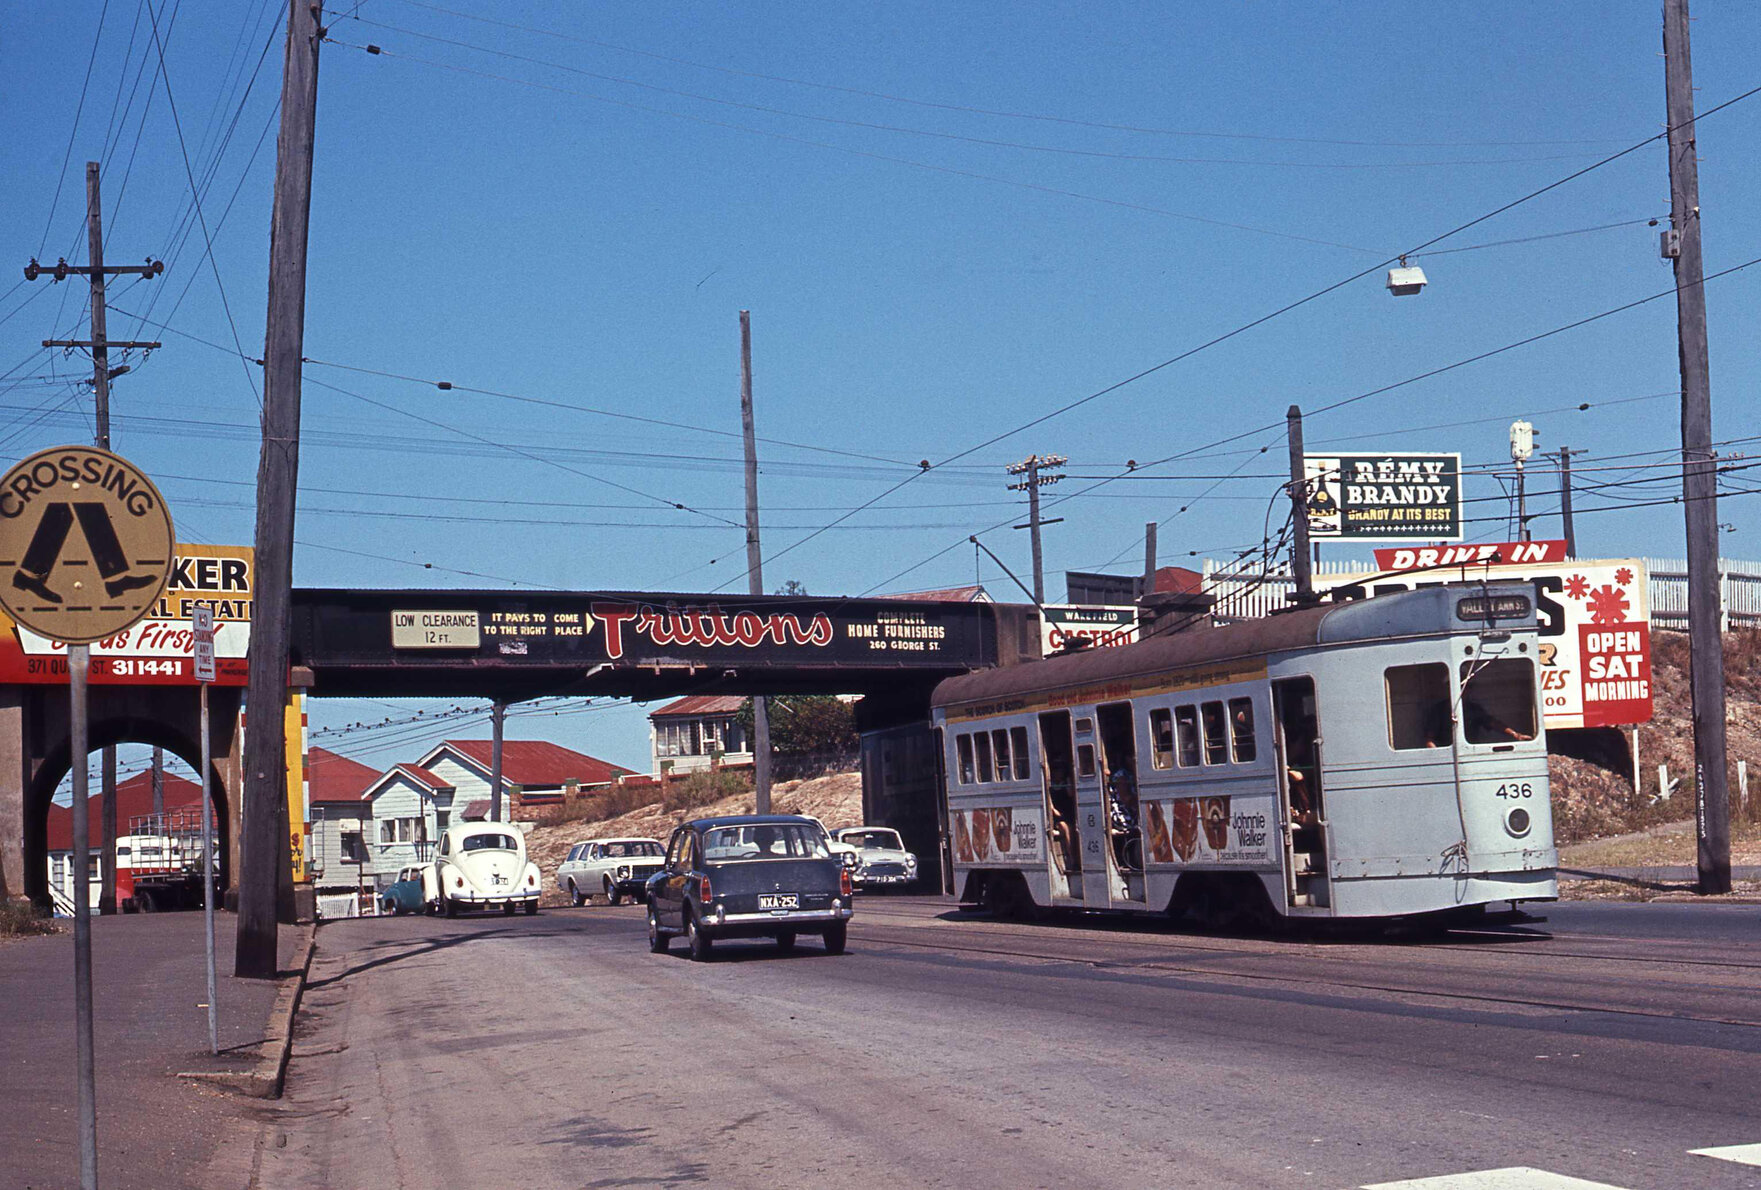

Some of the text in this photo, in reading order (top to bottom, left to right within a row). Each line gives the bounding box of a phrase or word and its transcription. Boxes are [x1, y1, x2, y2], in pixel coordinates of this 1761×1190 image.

[1354, 458, 1445, 483] RÉMY
[0, 456, 154, 519] CROSSING
[1347, 486, 1451, 505] BRANDY
[1348, 508, 1389, 521] BRANDY
[1391, 509, 1405, 521] AT
[1406, 508, 1422, 521] ITS
[1425, 508, 1451, 521] BEST
[1392, 543, 1549, 569] DRIVE IN
[1461, 600, 1496, 614] VALLY
[395, 614, 476, 627] LOW CLEARANCE
[492, 613, 579, 623] IT PAYS TO COME
[425, 631, 452, 643] 12 FT.
[484, 626, 583, 635] TO THE RIGHT PLACE
[590, 602, 833, 659] Trittons
[848, 624, 945, 639] HOME FURNISHERS
[870, 641, 941, 651] 260 GEORGE ST.
[1587, 631, 1640, 653] OPEN
[27, 660, 47, 675] 371
[1588, 655, 1643, 679] SAT
[1584, 679, 1649, 702] MORNING
[1496, 783, 1532, 799] 436
[1013, 821, 1037, 835] Johnnie
[1232, 812, 1266, 830] Johnnie
[1238, 829, 1266, 847] Walker
